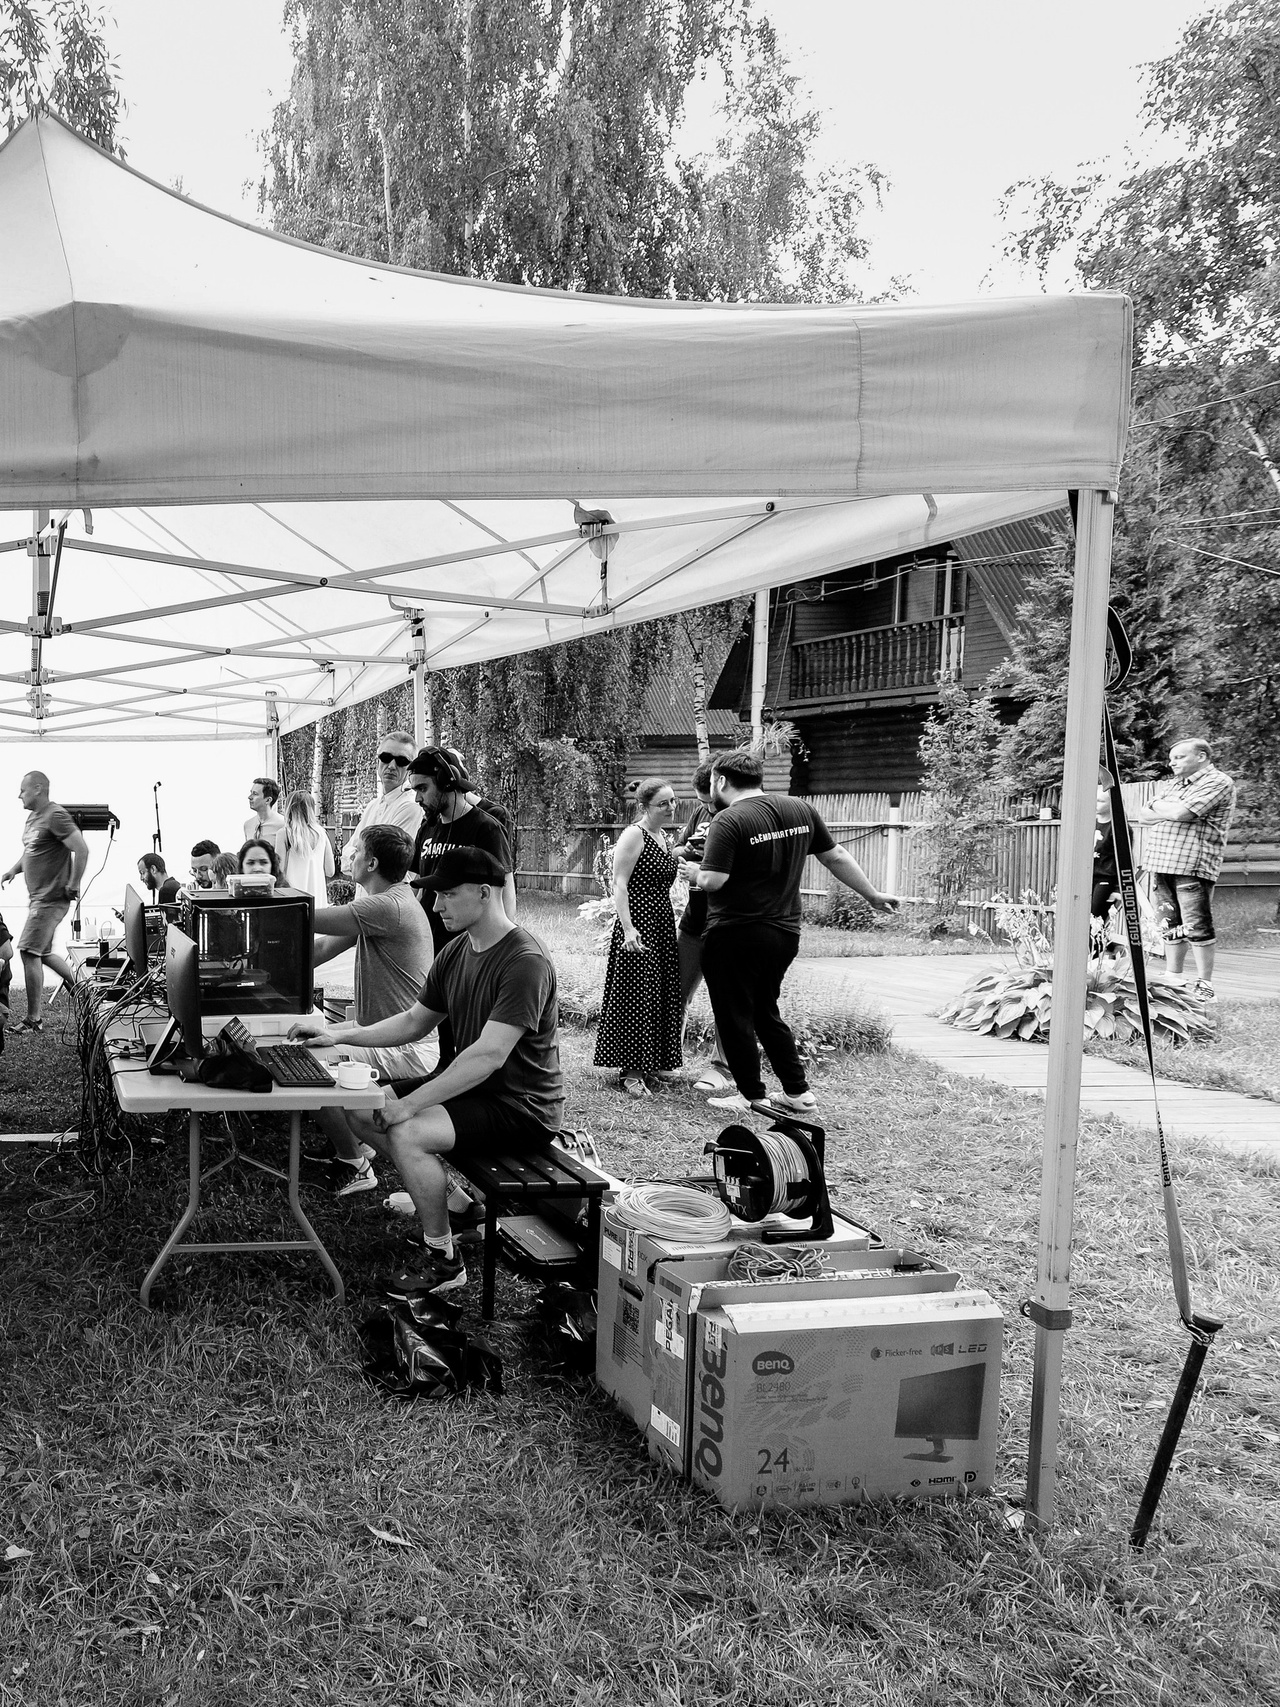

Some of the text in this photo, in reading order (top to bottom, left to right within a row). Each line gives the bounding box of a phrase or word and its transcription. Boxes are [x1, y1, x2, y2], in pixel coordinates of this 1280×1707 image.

[884, 1347, 923, 1358] Flicker-free
[958, 1343, 988, 1354] LED
[757, 1359, 790, 1370] BenQ
[757, 1447, 790, 1475] 24
